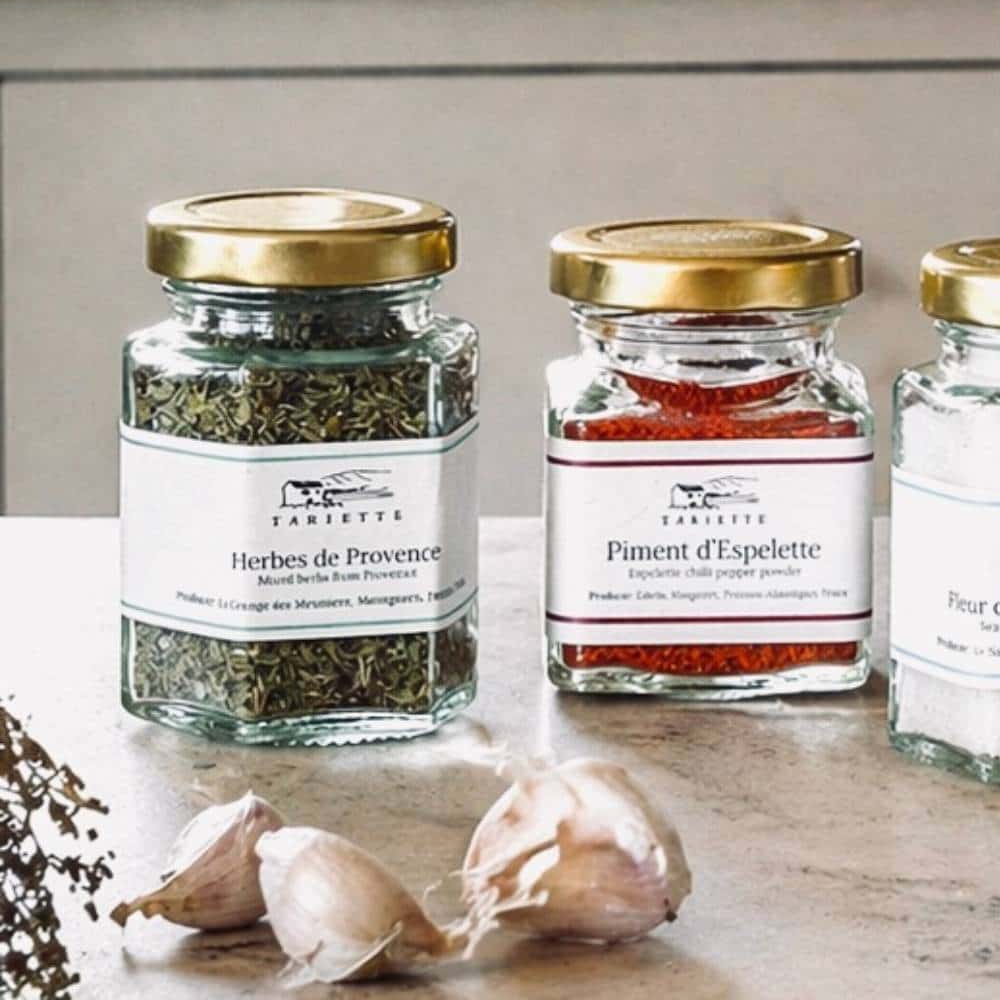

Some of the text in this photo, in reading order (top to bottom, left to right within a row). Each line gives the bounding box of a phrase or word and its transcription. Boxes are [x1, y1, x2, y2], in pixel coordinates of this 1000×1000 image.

[272, 509, 402, 527] TARIETTE
[232, 545, 442, 571] Herbes de Provence
[606, 538, 822, 565] Piment d'Espelette
[947, 590, 988, 614] Fleur
